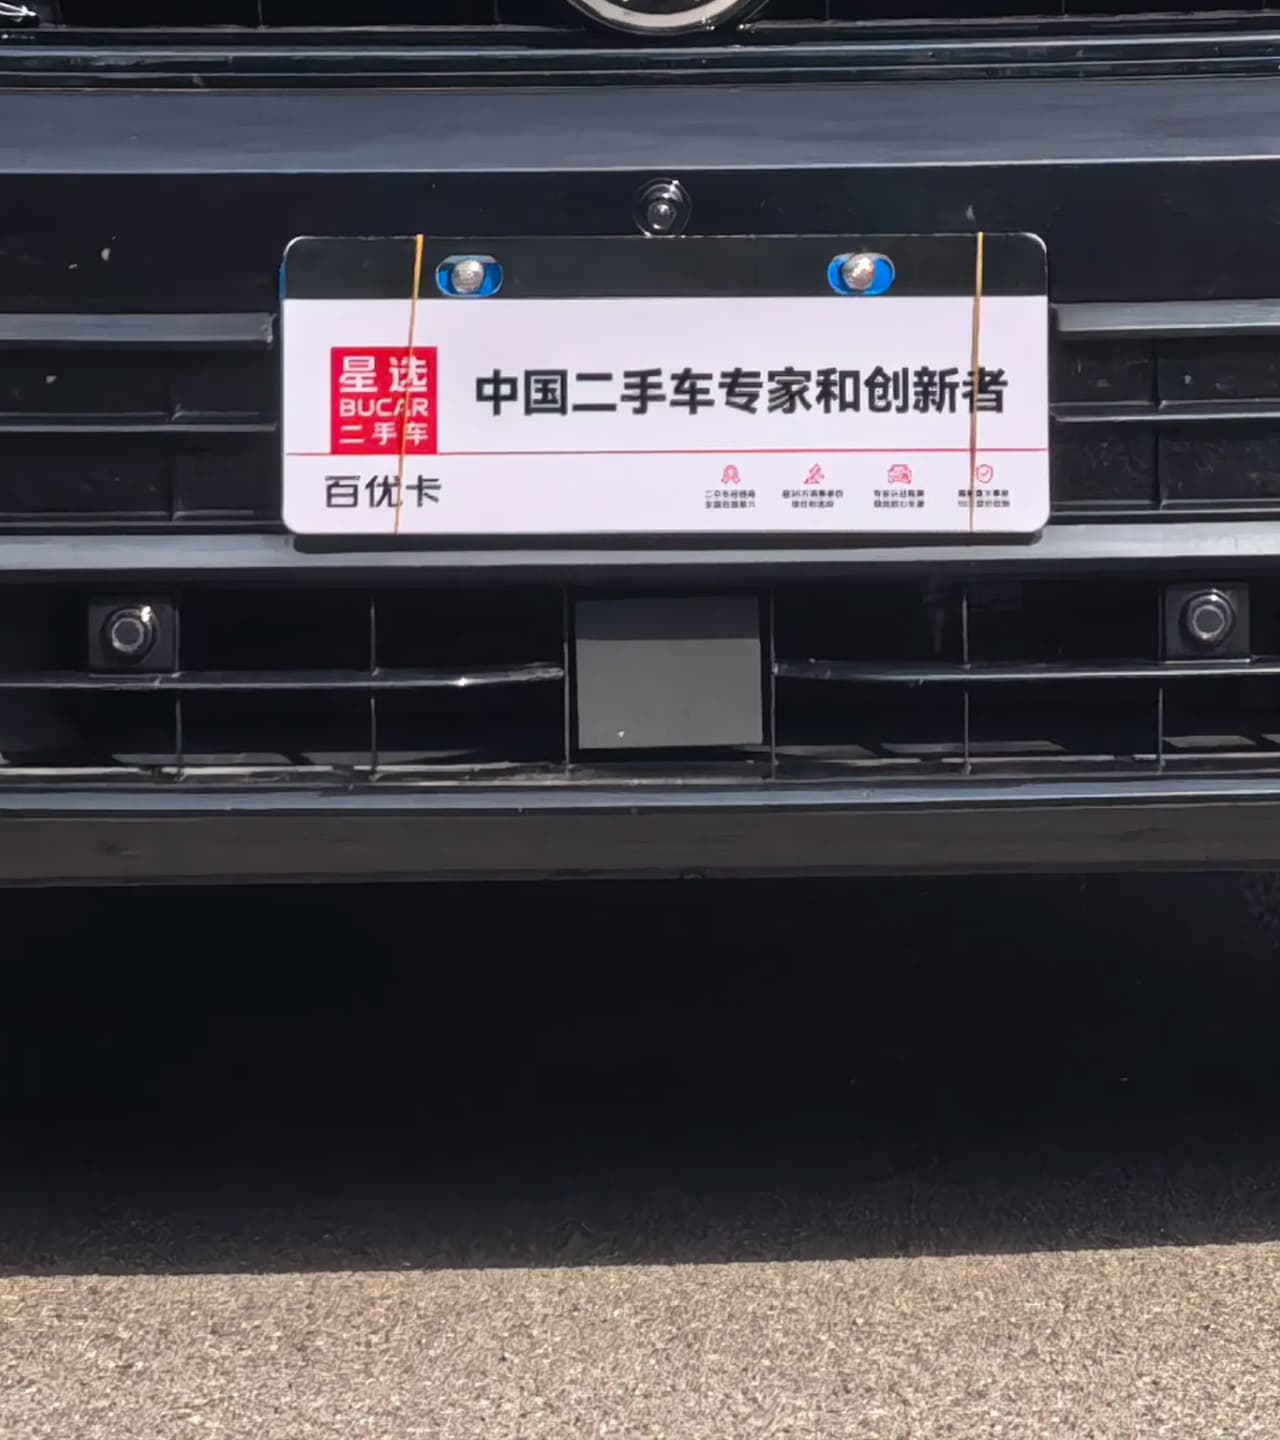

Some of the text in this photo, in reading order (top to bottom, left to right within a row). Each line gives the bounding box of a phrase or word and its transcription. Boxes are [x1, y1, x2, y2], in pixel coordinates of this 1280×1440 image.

[339, 355, 428, 393] 星选
[339, 398, 429, 417] BUCAR
[475, 366, 1009, 417] 中国二手车专家和创新者
[338, 422, 429, 446] 二手车
[325, 474, 442, 508] 百优卡
